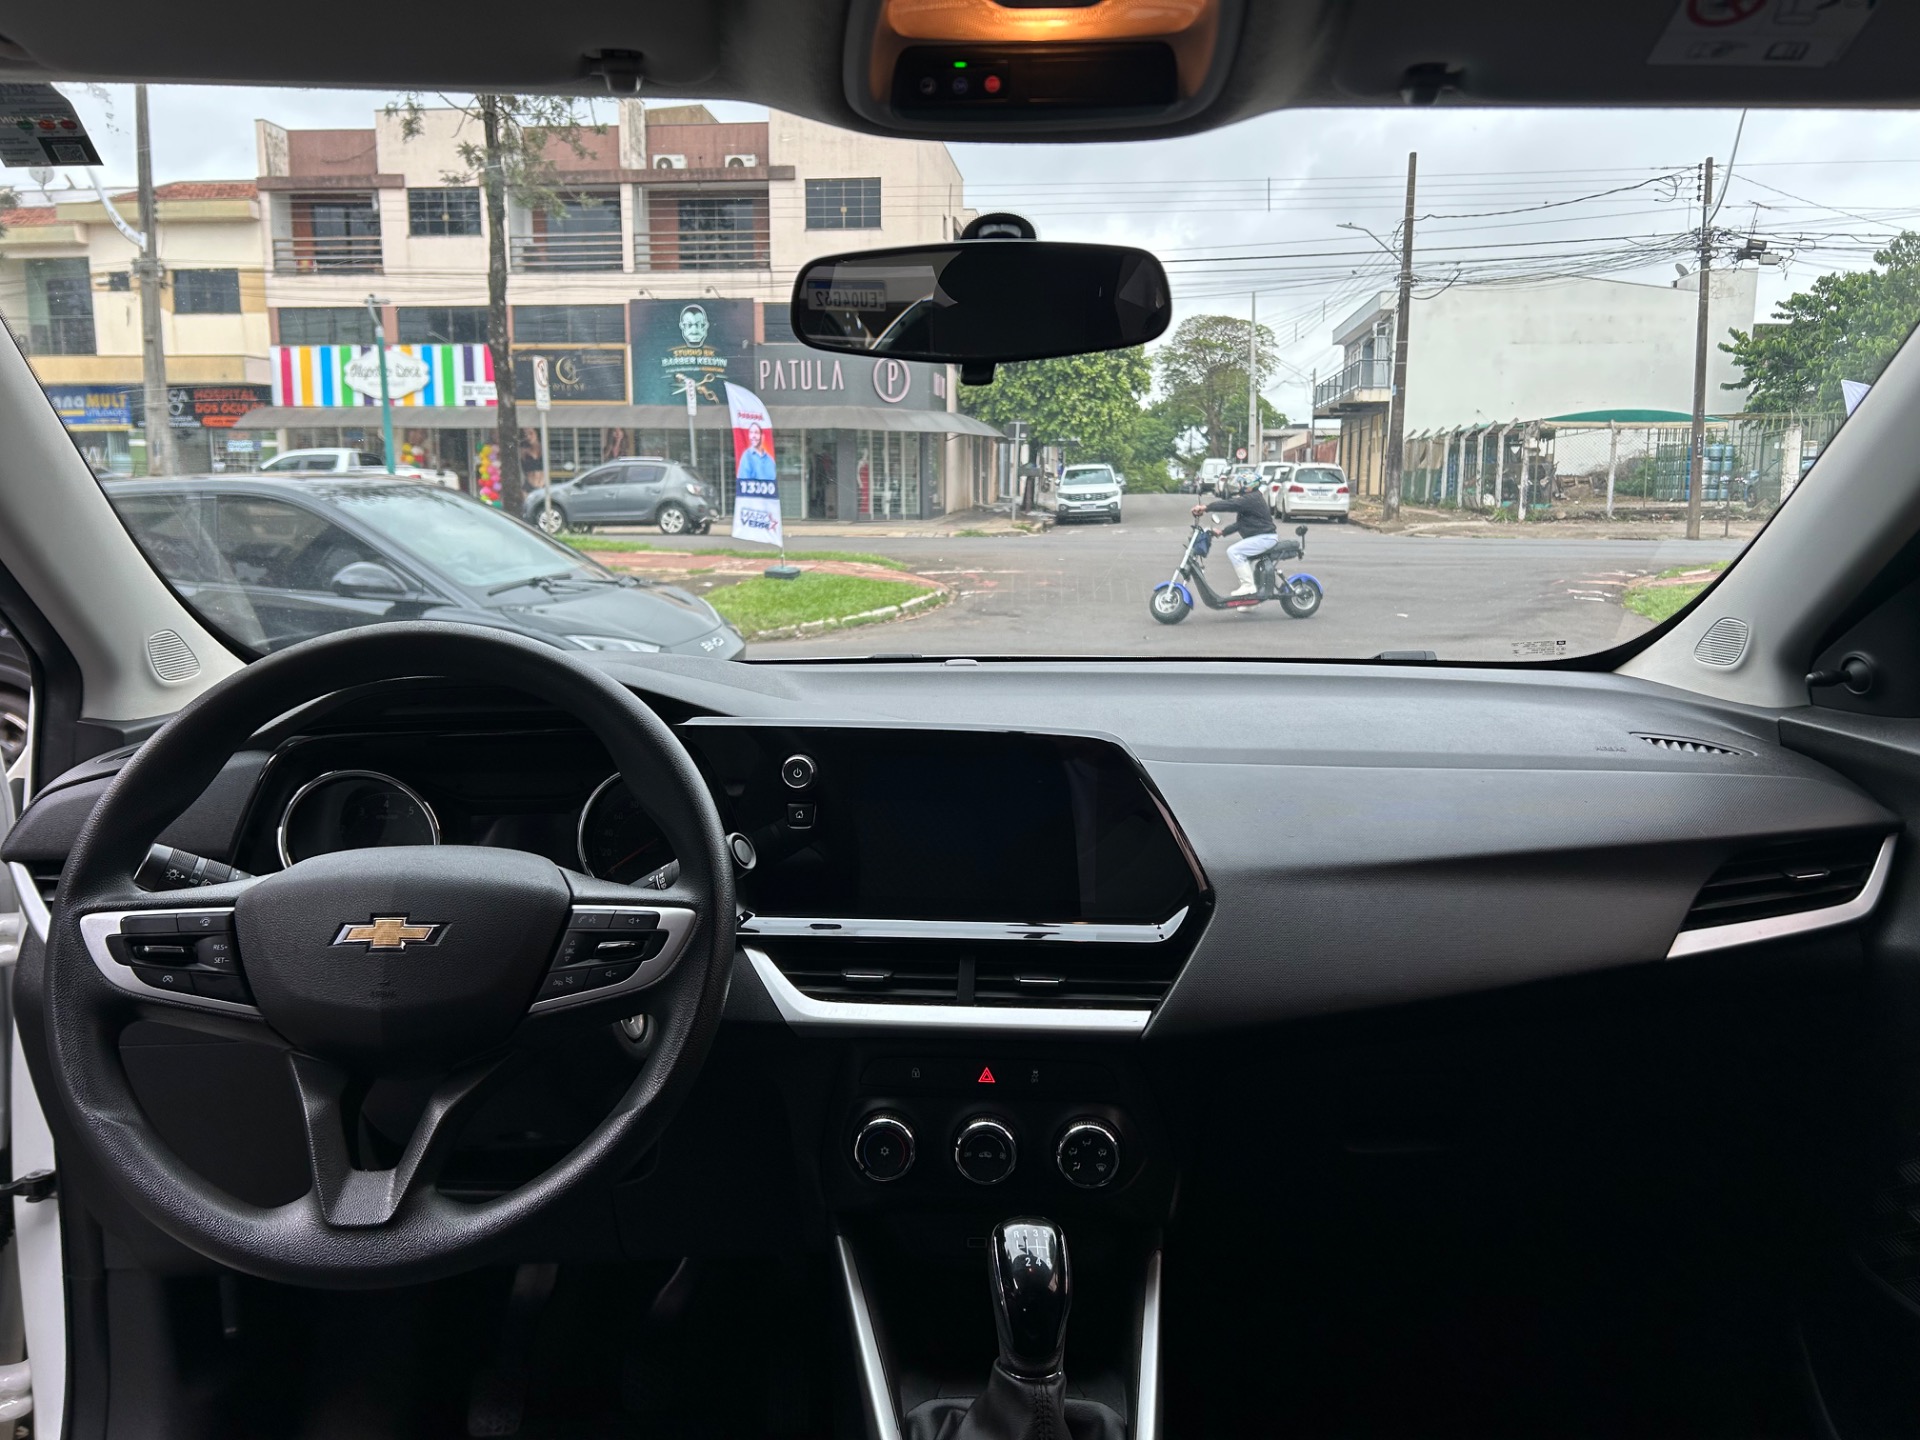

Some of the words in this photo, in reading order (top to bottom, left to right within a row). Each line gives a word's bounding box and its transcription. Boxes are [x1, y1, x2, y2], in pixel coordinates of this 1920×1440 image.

[661, 357, 696, 367] BARBER
[697, 357, 728, 367] KELVIN
[759, 359, 845, 391] PATULA
[887, 361, 899, 395] P
[193, 388, 257, 401] HOSPITAL
[195, 402, 219, 414] DOS
[1013, 1230, 1020, 1239] R
[1032, 1229, 1039, 1237] 3
[1042, 1229, 1048, 1238] 5
[1025, 1257, 1031, 1267] 2
[1035, 1257, 1042, 1267] 4
